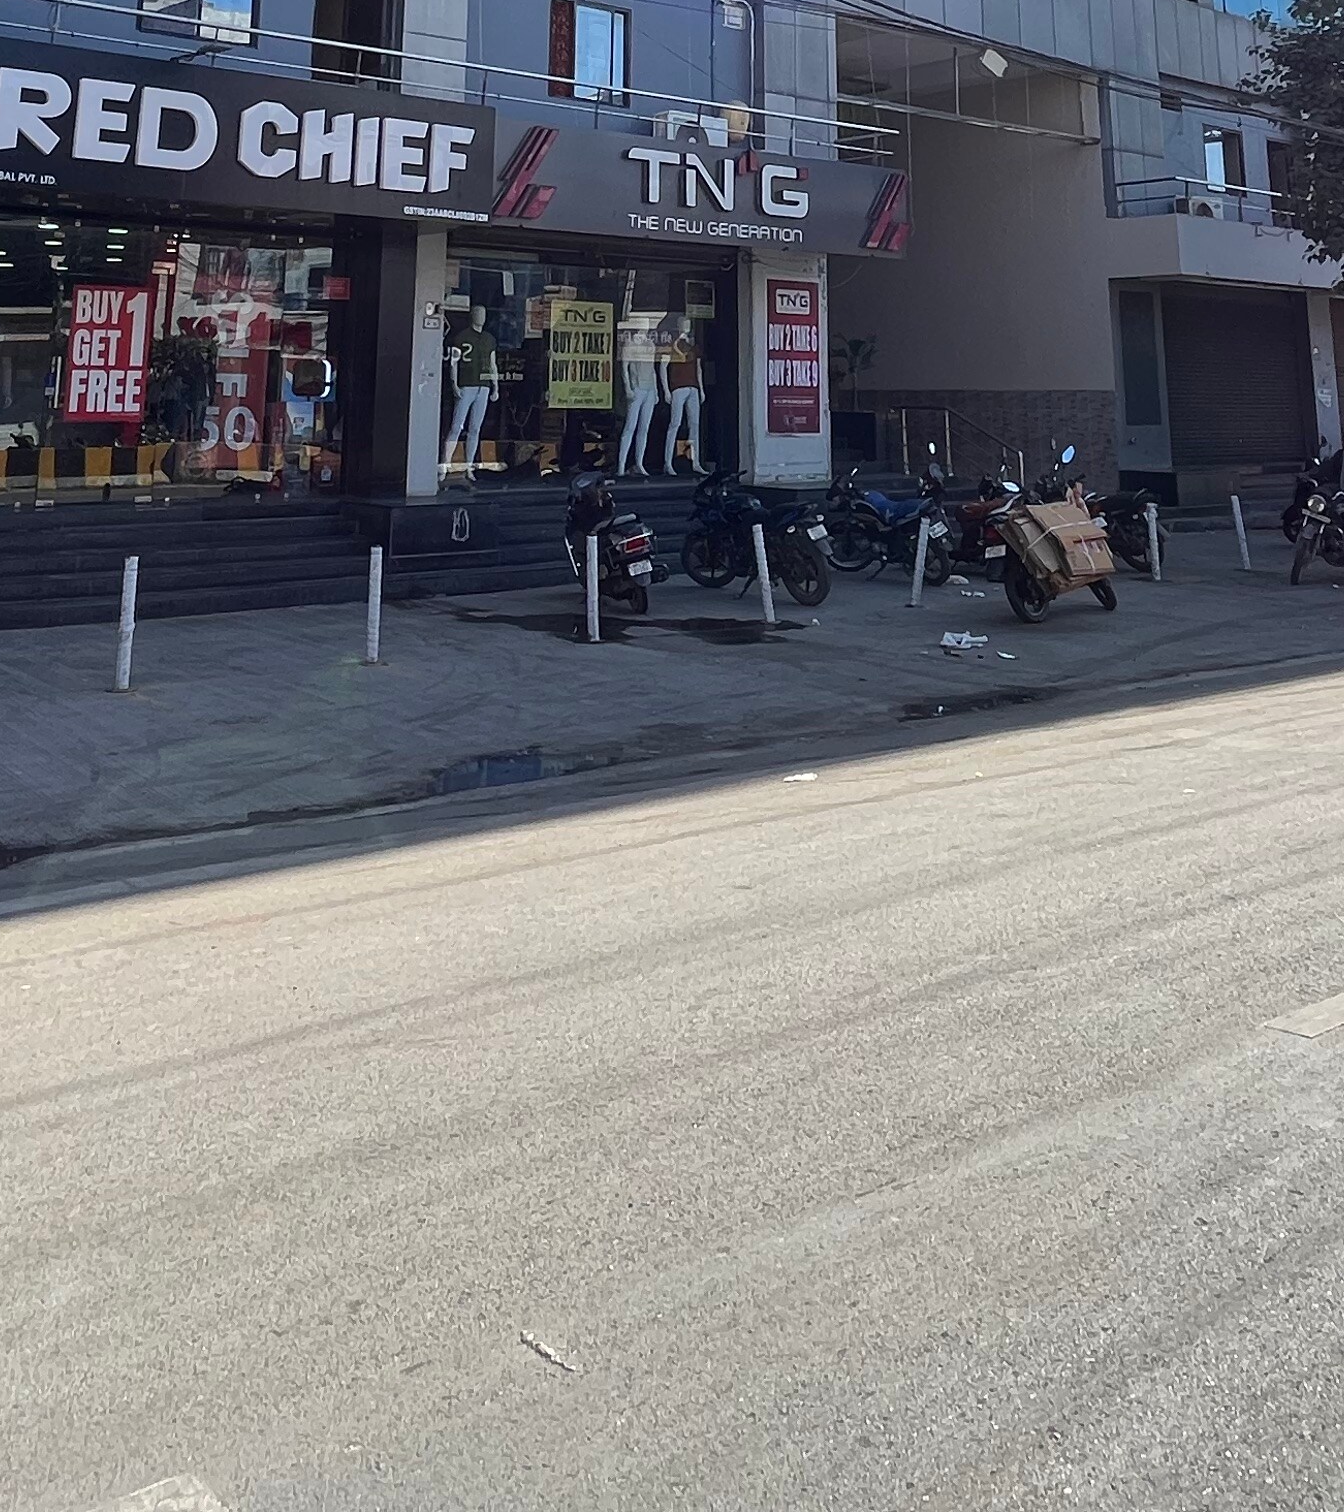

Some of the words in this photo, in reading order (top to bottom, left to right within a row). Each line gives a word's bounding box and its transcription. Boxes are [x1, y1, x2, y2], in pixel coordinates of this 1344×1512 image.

[237, 100, 476, 193] CHIEF
[627, 213, 659, 230] THE
[664, 217, 703, 235] NEW
[707, 221, 803, 243] GENERATION
[75, 289, 125, 325] BUY
[126, 291, 148, 367] 1
[553, 331, 572, 353] BUY
[573, 331, 581, 353] 2
[582, 332, 605, 354] TAKE
[769, 323, 785, 351] BUY
[785, 324, 792, 351] 2
[792, 324, 811, 352] TAKE
[72, 329, 121, 367] GET
[552, 359, 570, 382] BUY
[578, 360, 600, 382] TAKE
[769, 359, 785, 386] BUY
[785, 359, 792, 387] 3
[792, 360, 811, 387] TAKE
[68, 370, 143, 413] FREE
